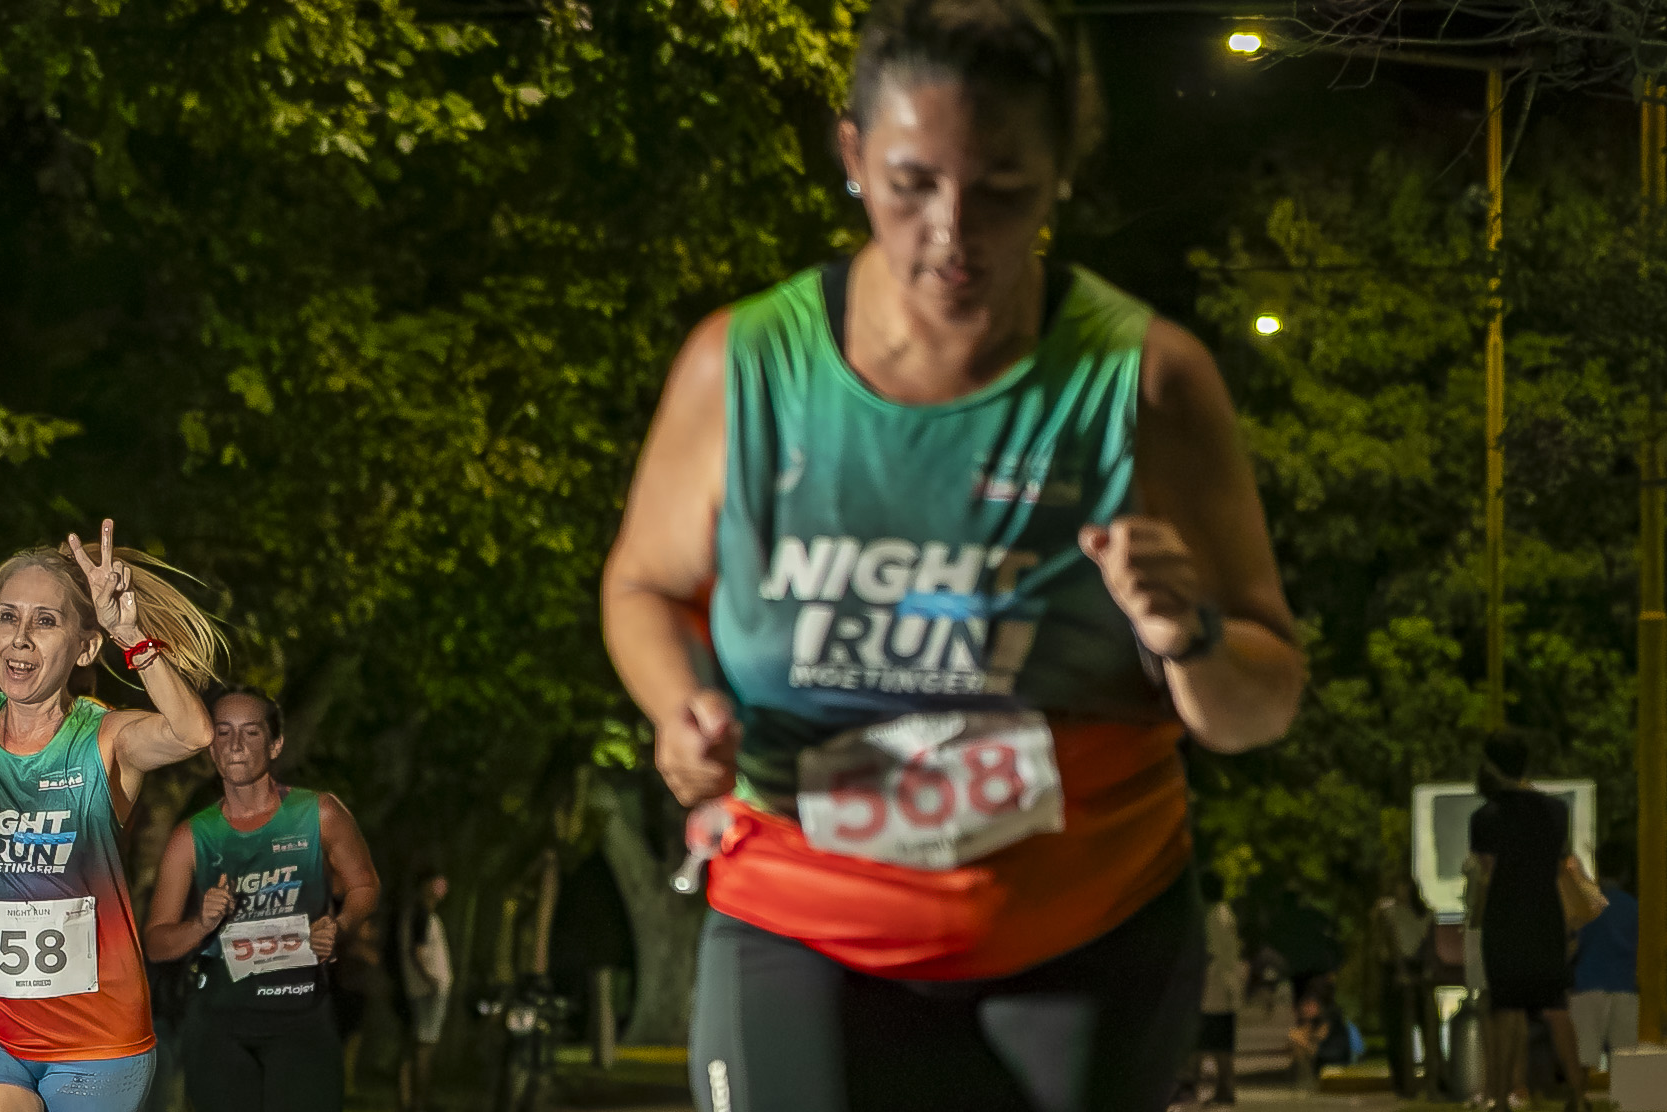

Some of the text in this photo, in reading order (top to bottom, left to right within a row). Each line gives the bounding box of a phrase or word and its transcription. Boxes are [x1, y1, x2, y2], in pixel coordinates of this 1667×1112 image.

[759, 535, 1038, 605] NIGHT
[829, 742, 1024, 843] 568
[235, 866, 298, 893] IGHT
[7, 909, 31, 917] NIGHT
[33, 908, 51, 916] RUN
[0, 929, 68, 976] 58
